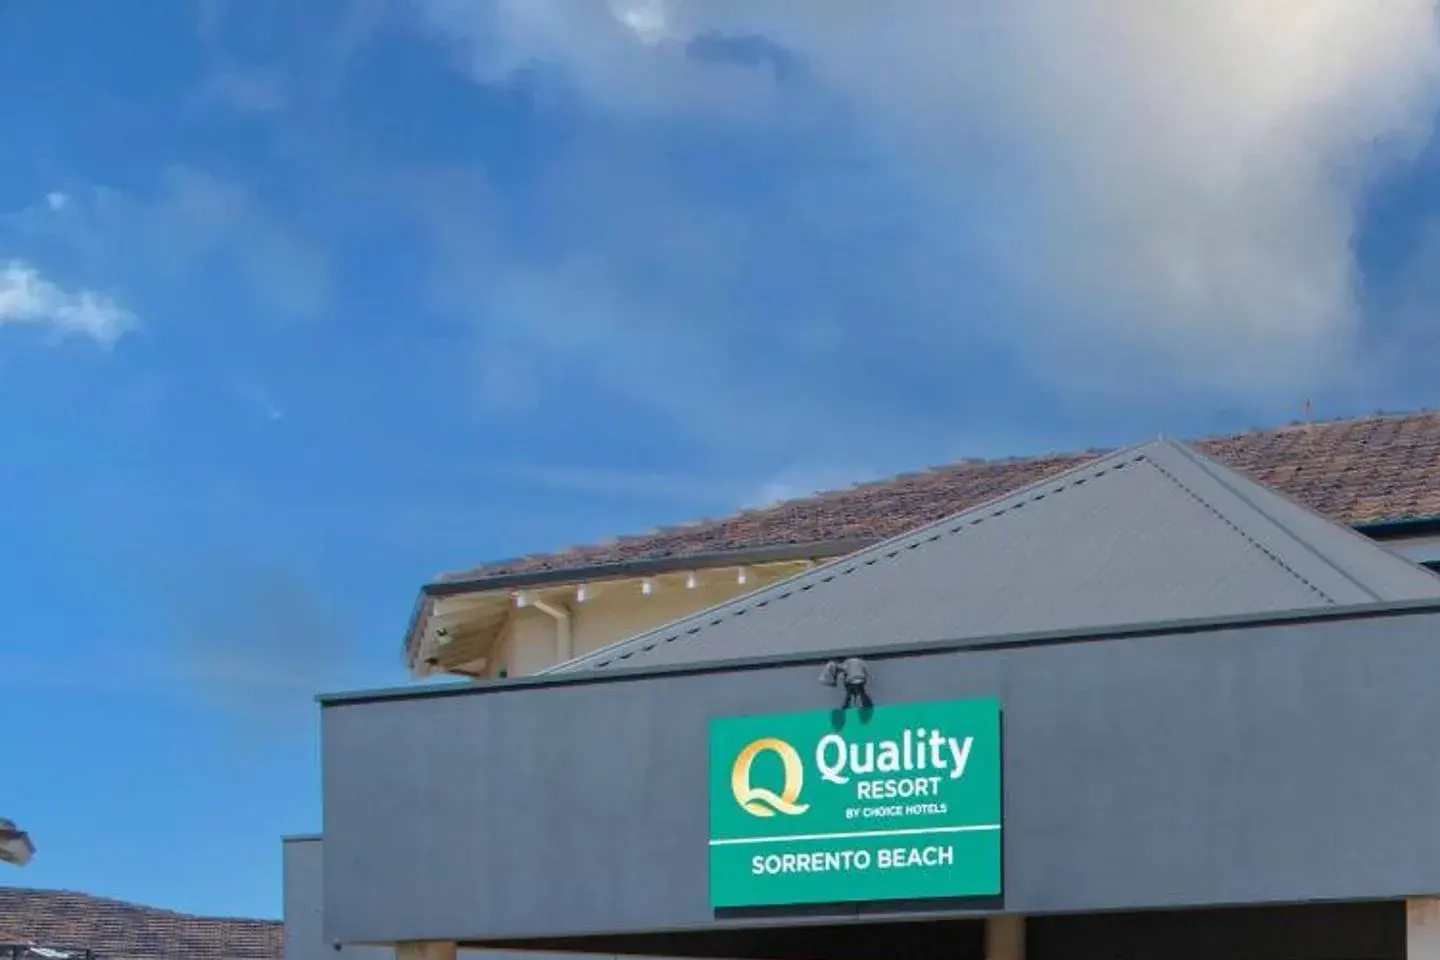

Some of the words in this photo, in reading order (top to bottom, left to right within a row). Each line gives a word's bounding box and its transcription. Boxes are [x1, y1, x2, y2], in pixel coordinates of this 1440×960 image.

[816, 728, 973, 784] Quality
[731, 738, 810, 817] Q
[857, 776, 942, 800] RESORT
[846, 807, 860, 819] BY
[863, 805, 902, 818] CHOICE
[905, 803, 948, 815] HOTELS
[752, 849, 871, 875] SORRENTO
[877, 846, 953, 869] BEACH
